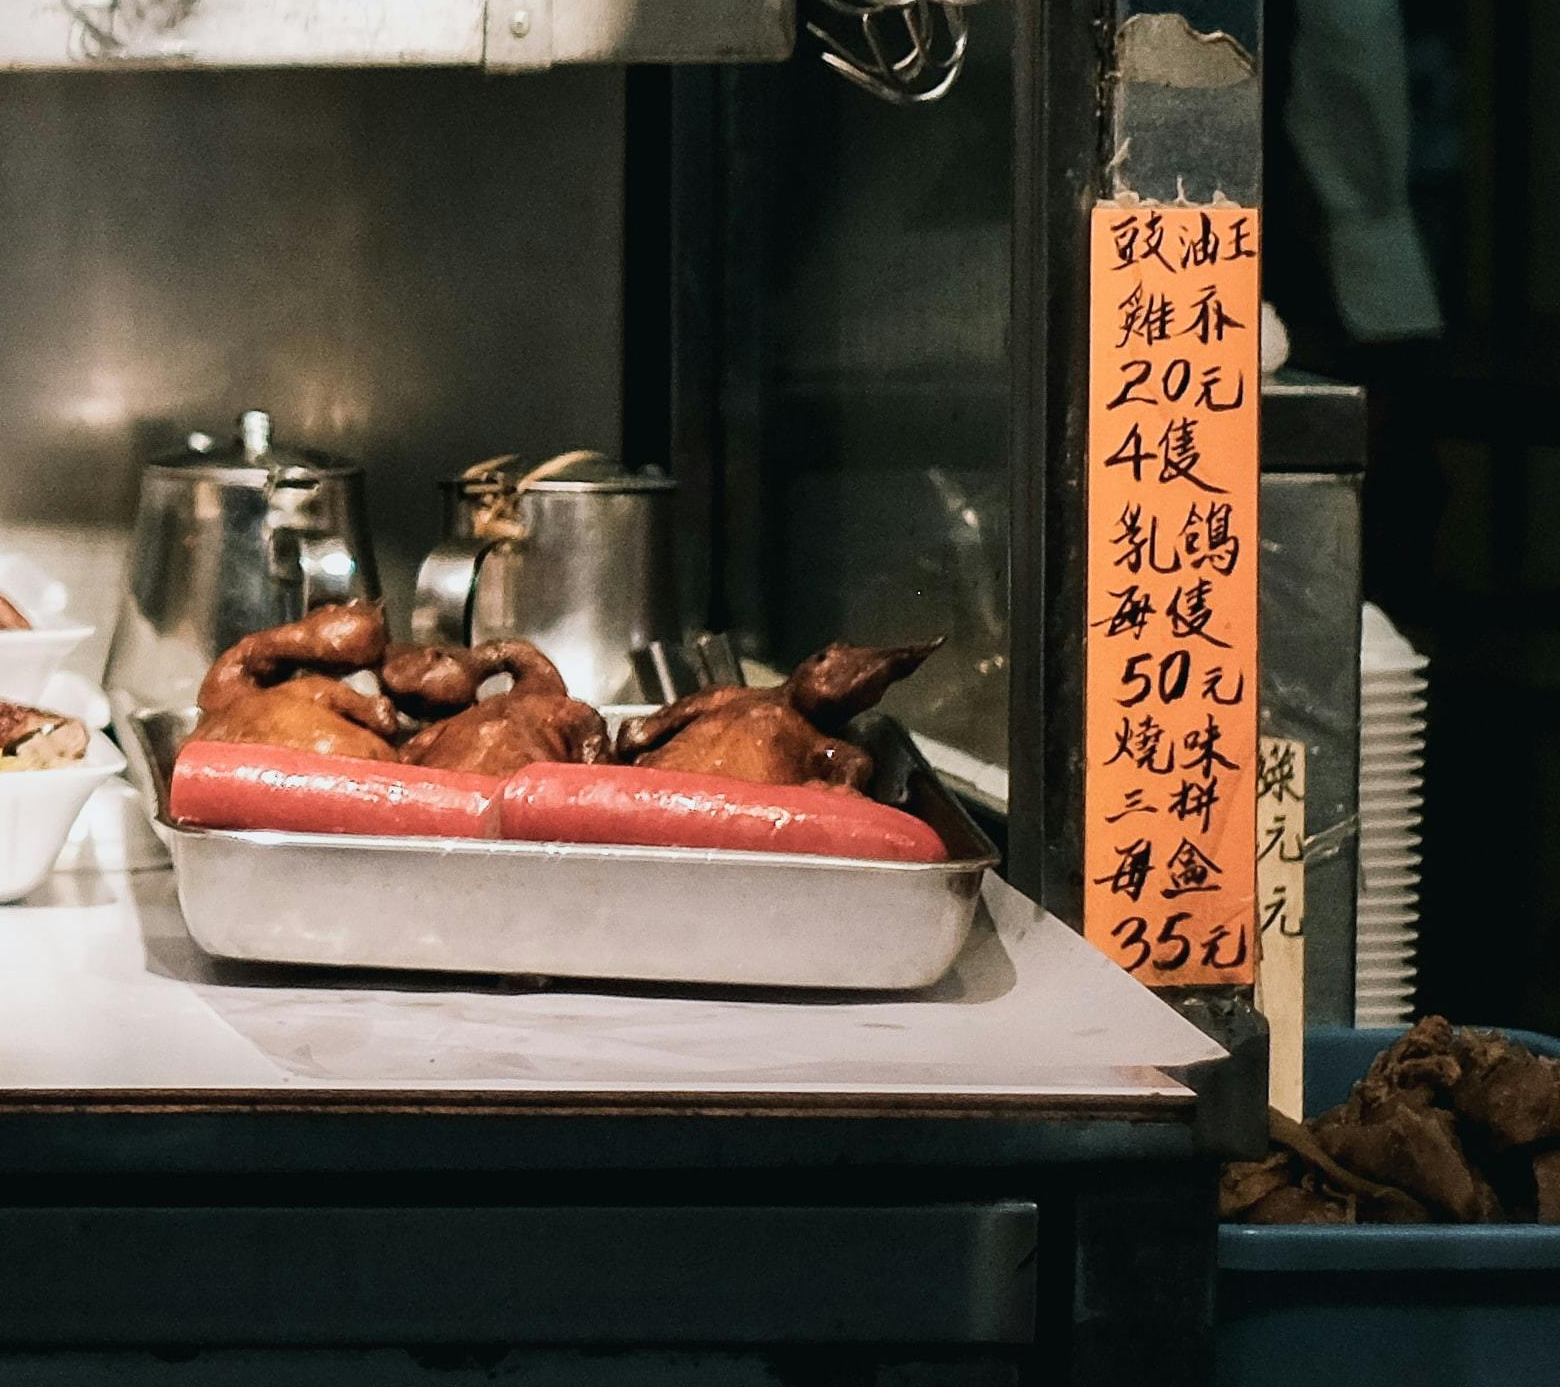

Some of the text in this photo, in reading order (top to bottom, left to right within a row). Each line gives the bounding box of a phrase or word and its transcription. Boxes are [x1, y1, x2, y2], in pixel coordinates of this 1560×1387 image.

[1106, 358, 1244, 412] 20元
[1103, 416, 1232, 495] 4隻
[1108, 499, 1240, 577] 乳鴿
[1090, 576, 1234, 649] 每隻
[1114, 649, 1244, 708] 50元
[1102, 713, 1241, 780] 燒味
[1104, 775, 1220, 834] 三拼
[1110, 911, 1248, 974] 35元
